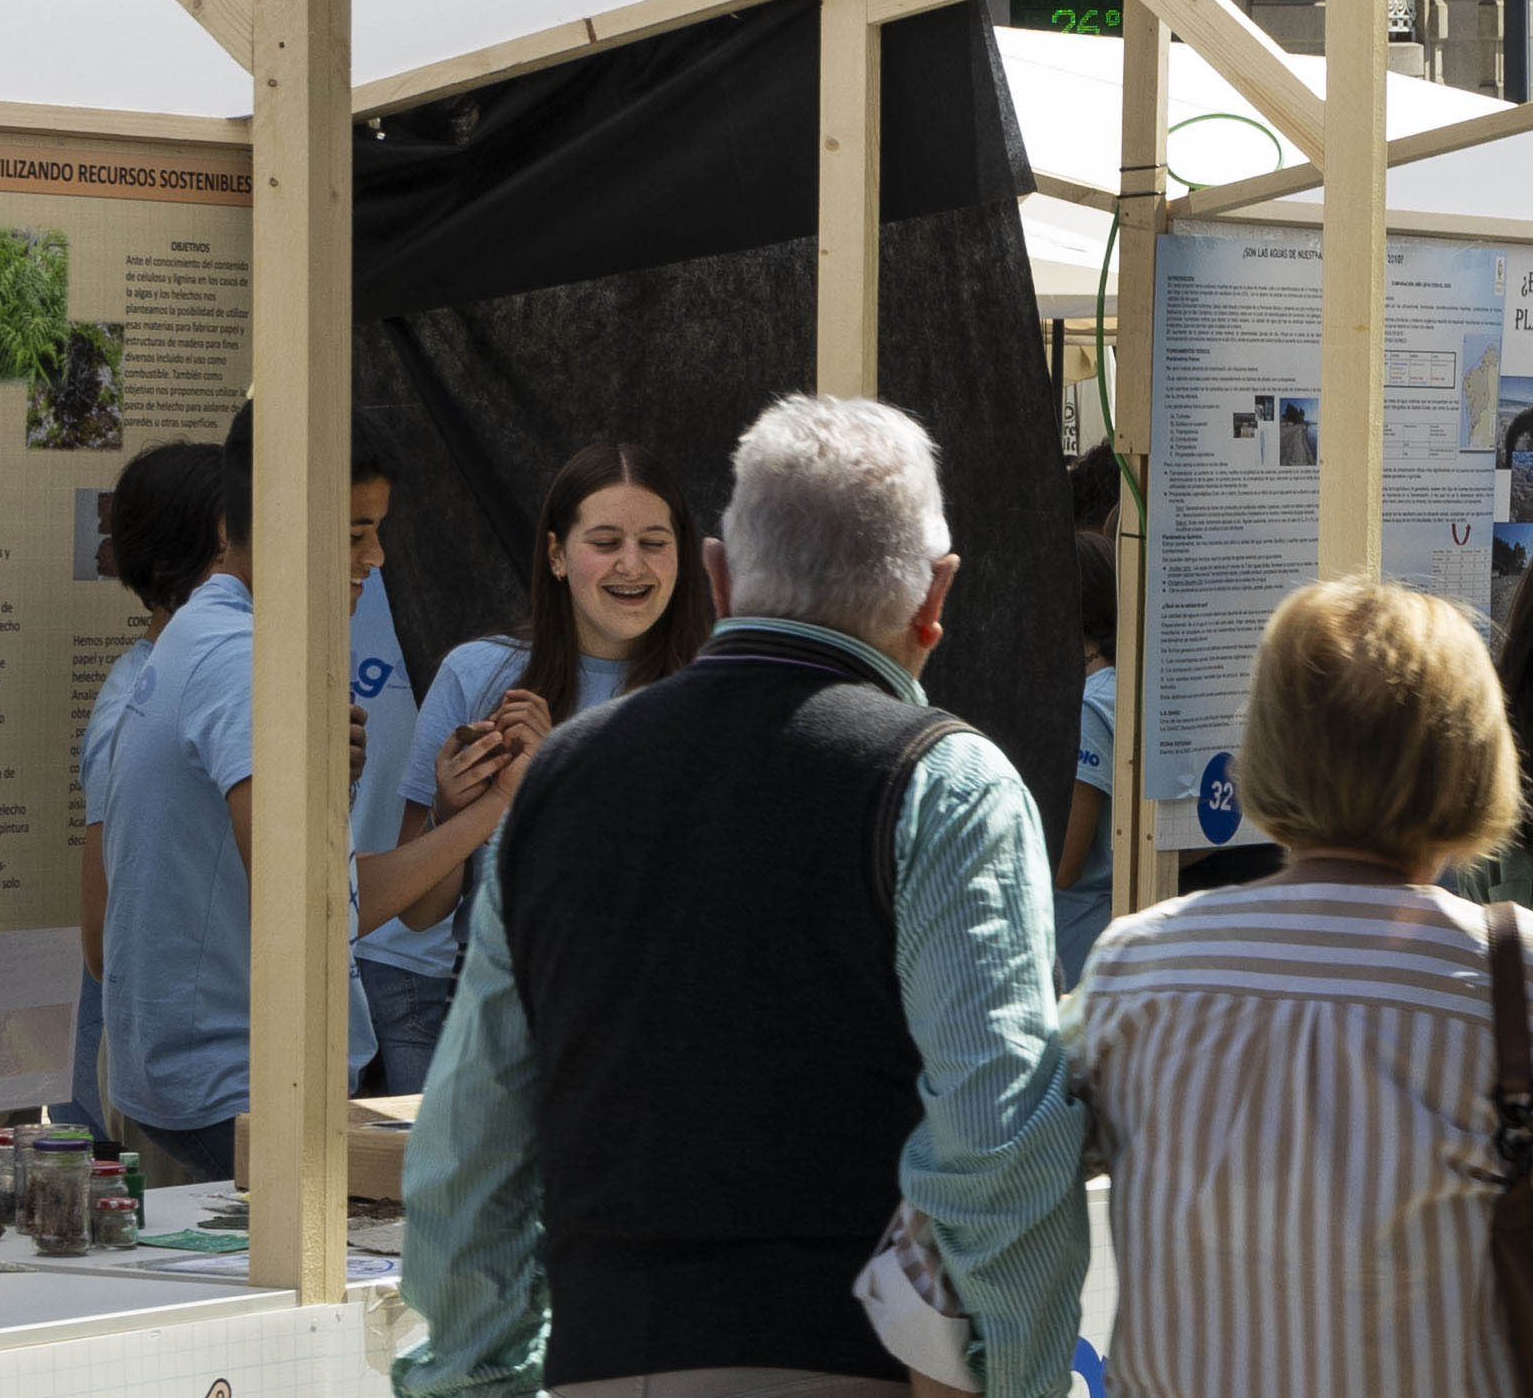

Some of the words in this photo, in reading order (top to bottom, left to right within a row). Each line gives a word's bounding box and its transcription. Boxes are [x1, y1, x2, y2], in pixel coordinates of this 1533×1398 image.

[78, 164, 156, 187] RECURSOS
[159, 169, 252, 194] SOSTENIBLES
[171, 241, 210, 252] OBJETIVOS
[1298, 250, 1324, 260] NUESTRA
[1208, 780, 1233, 811] 32
